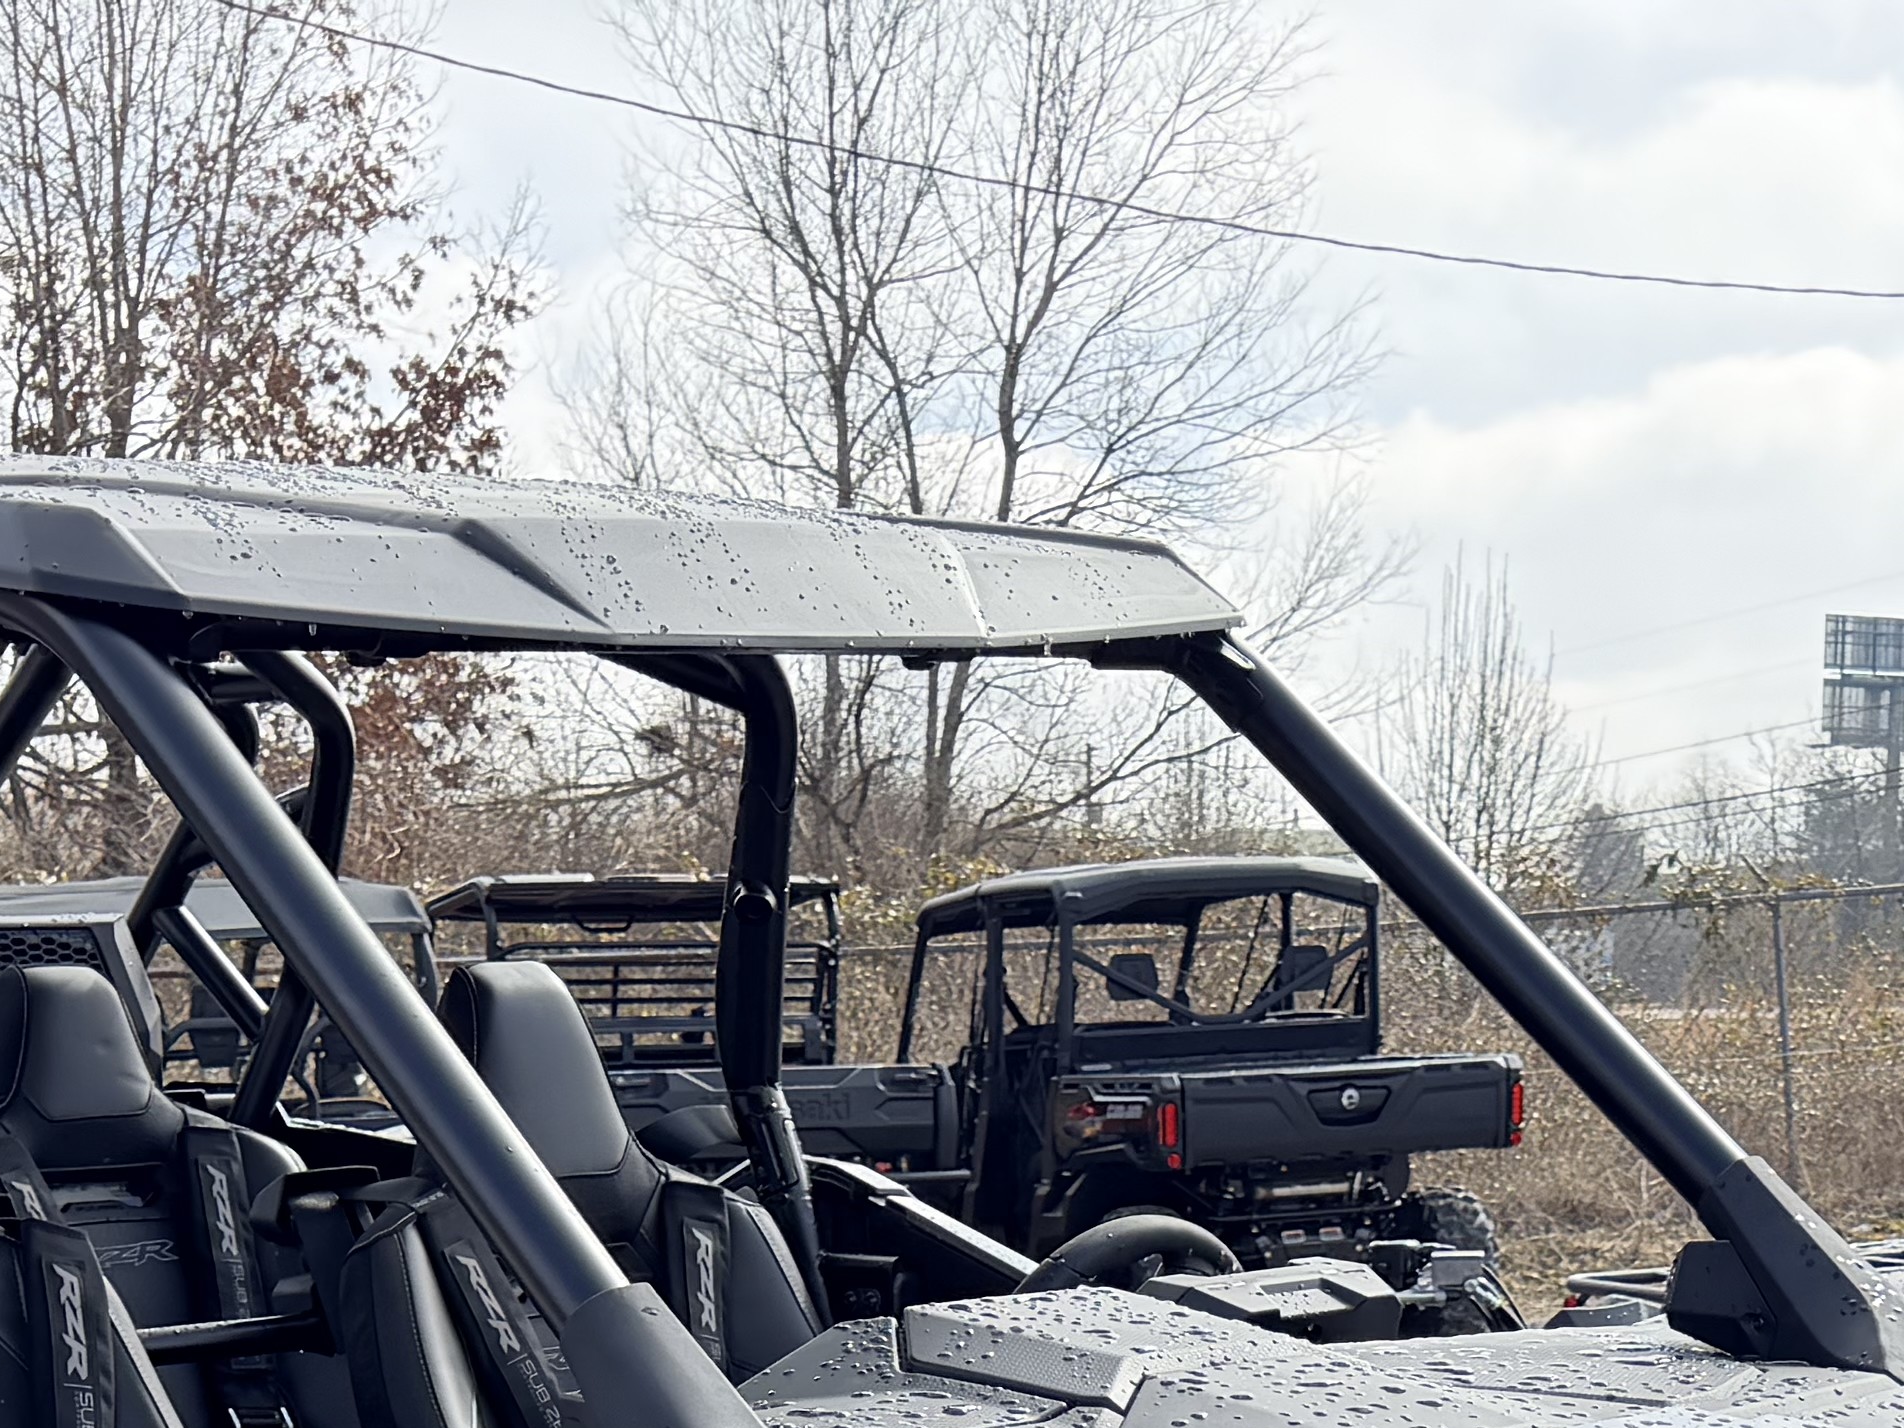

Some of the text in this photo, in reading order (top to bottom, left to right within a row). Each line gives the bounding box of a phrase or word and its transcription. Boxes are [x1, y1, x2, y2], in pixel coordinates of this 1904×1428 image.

[205, 1163, 240, 1257] RZR
[52, 1263, 89, 1381] RZR
[455, 1254, 552, 1405] RZR SUB
[691, 1227, 717, 1333] RZR
